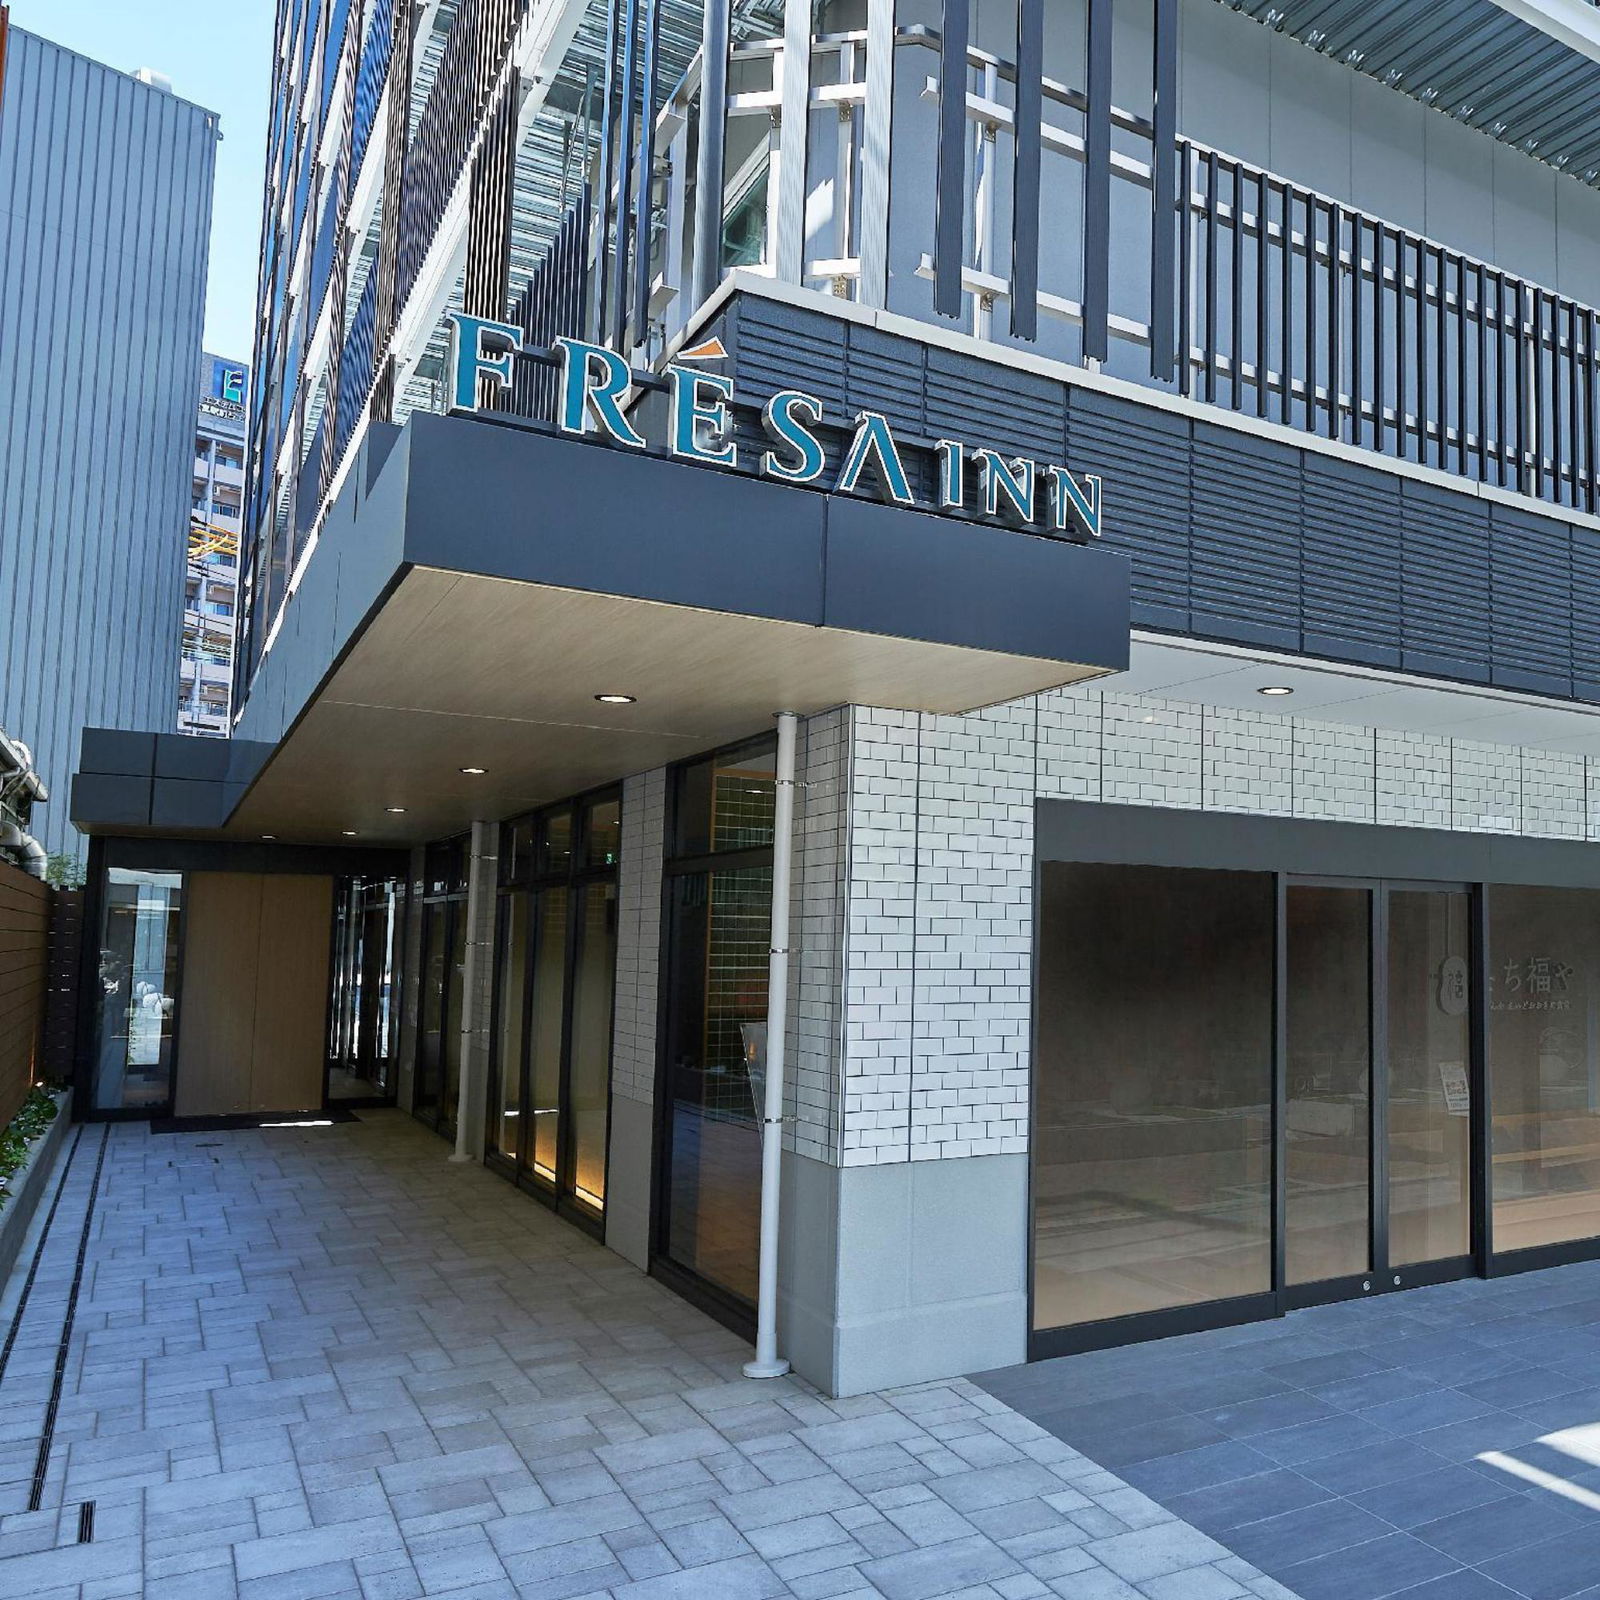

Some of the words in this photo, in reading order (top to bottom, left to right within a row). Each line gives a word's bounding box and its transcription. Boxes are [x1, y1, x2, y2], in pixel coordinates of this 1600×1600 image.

[935, 439, 1102, 539] INN
[1489, 956, 1573, 994] ち福や
